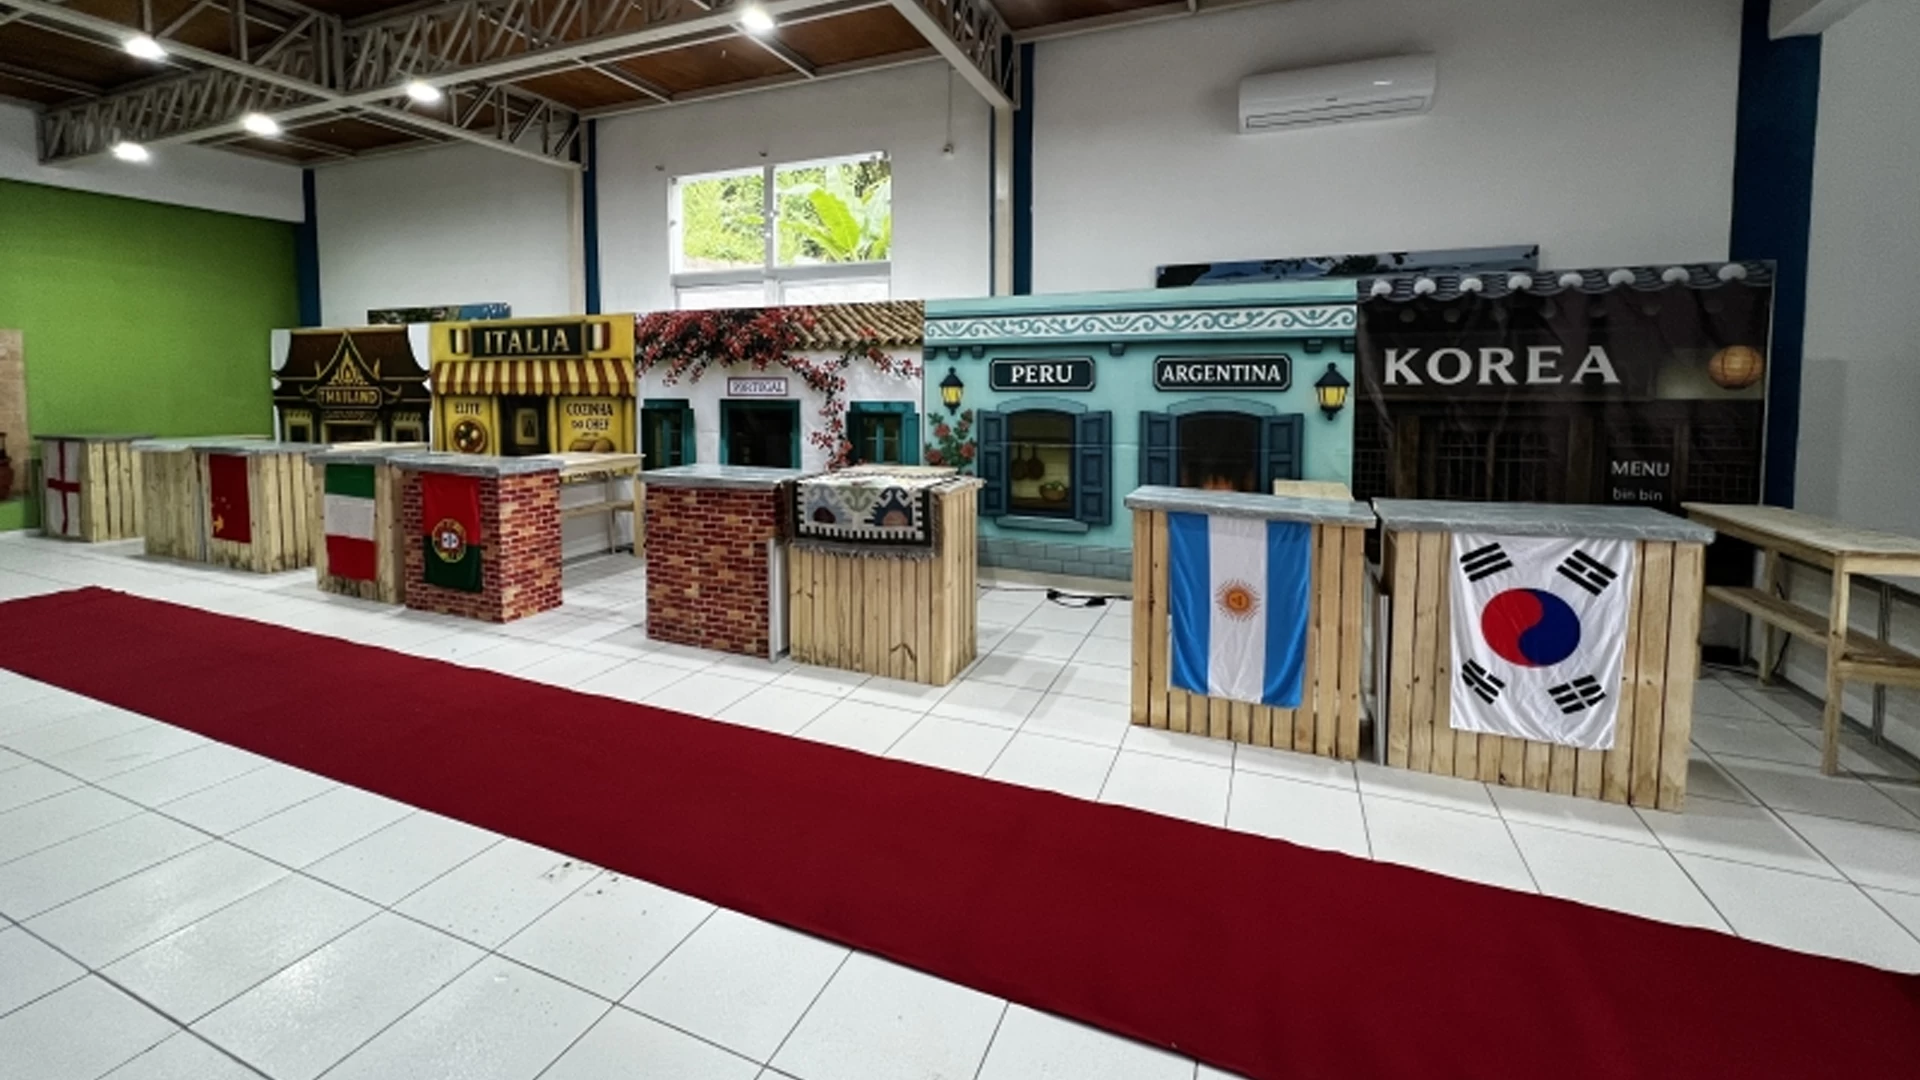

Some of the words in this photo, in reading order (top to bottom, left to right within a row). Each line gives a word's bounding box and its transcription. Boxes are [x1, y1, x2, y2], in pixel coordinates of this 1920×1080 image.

[484, 328, 570, 353] ITALIA
[1011, 364, 1074, 383] PERU
[1161, 363, 1282, 383] ARGENTINA
[1383, 345, 1621, 385] KOREA
[320, 390, 378, 404] THAILAND
[1611, 460, 1670, 477] MENU
[1639, 488, 1663, 501] bin
